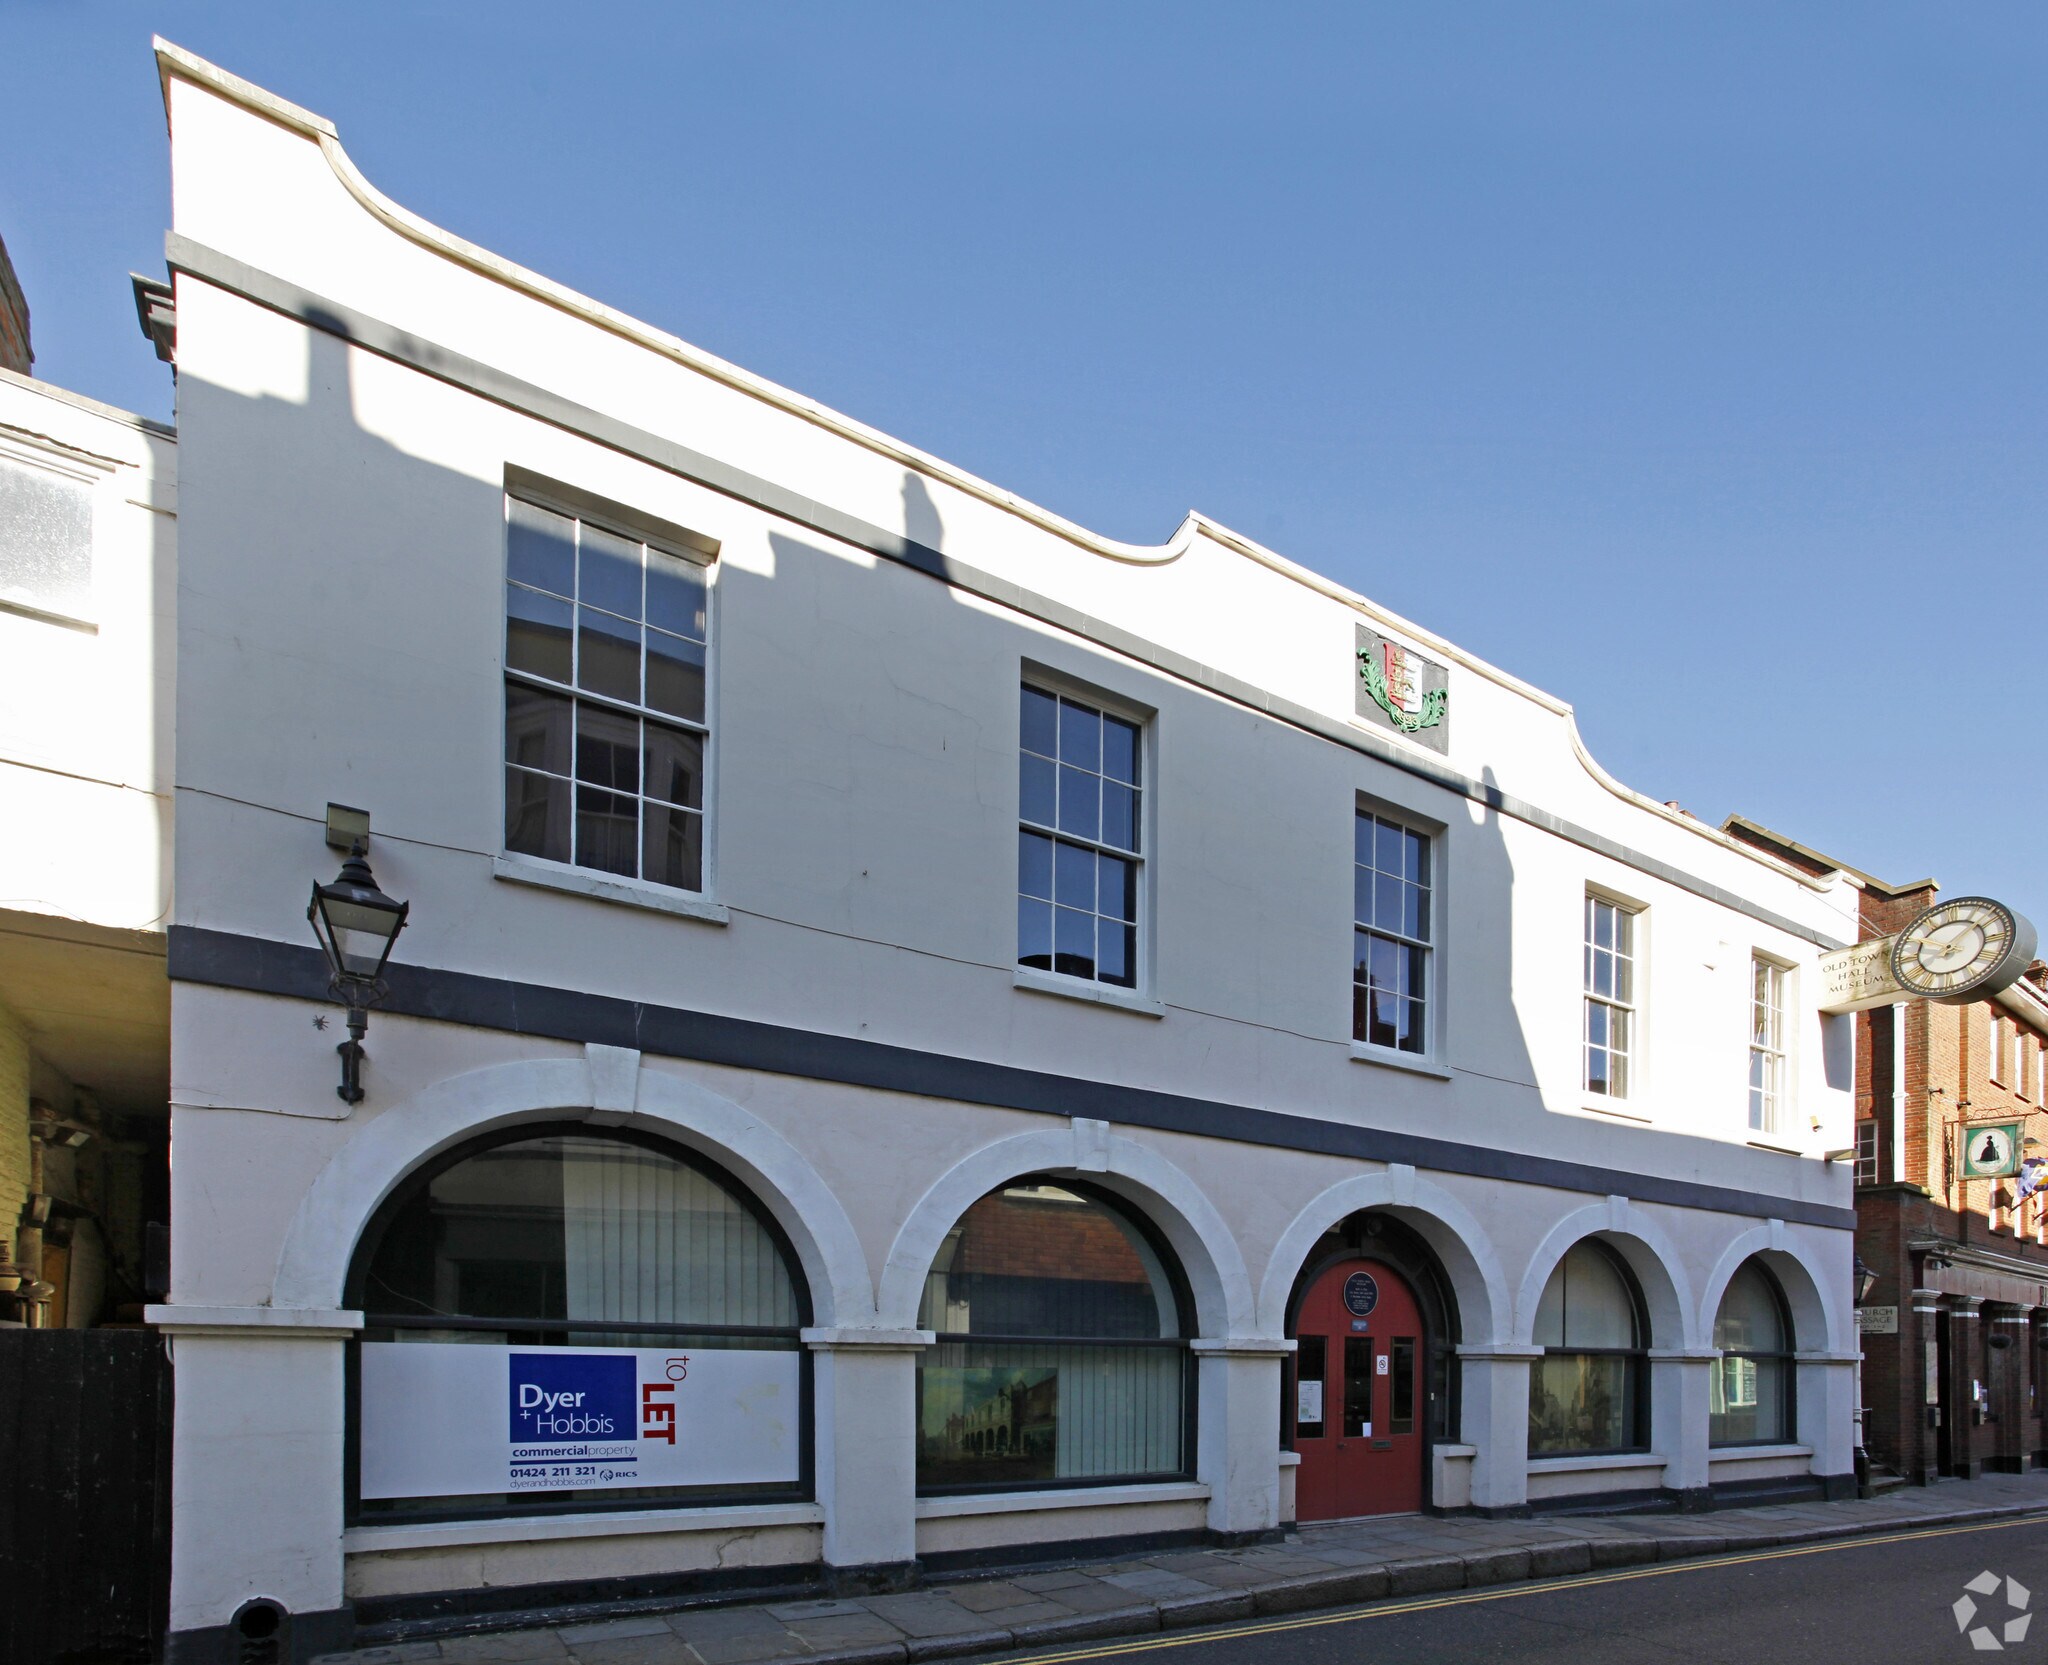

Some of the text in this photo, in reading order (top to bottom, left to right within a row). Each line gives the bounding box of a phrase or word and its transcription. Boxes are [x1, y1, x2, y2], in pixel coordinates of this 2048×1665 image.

[1822, 950, 1890, 973] OLD TOWN
[1838, 967, 1871, 981] HALL
[1829, 975, 1884, 993] MUSEUM
[519, 1384, 586, 1413] Dyer
[642, 1355, 690, 1446] to LET
[537, 1413, 614, 1435] Hobbis
[512, 1445, 636, 1458] commercialproperty
[510, 1466, 596, 1478] 01424 211 321
[509, 1478, 596, 1490] dyerandhobbis.com
